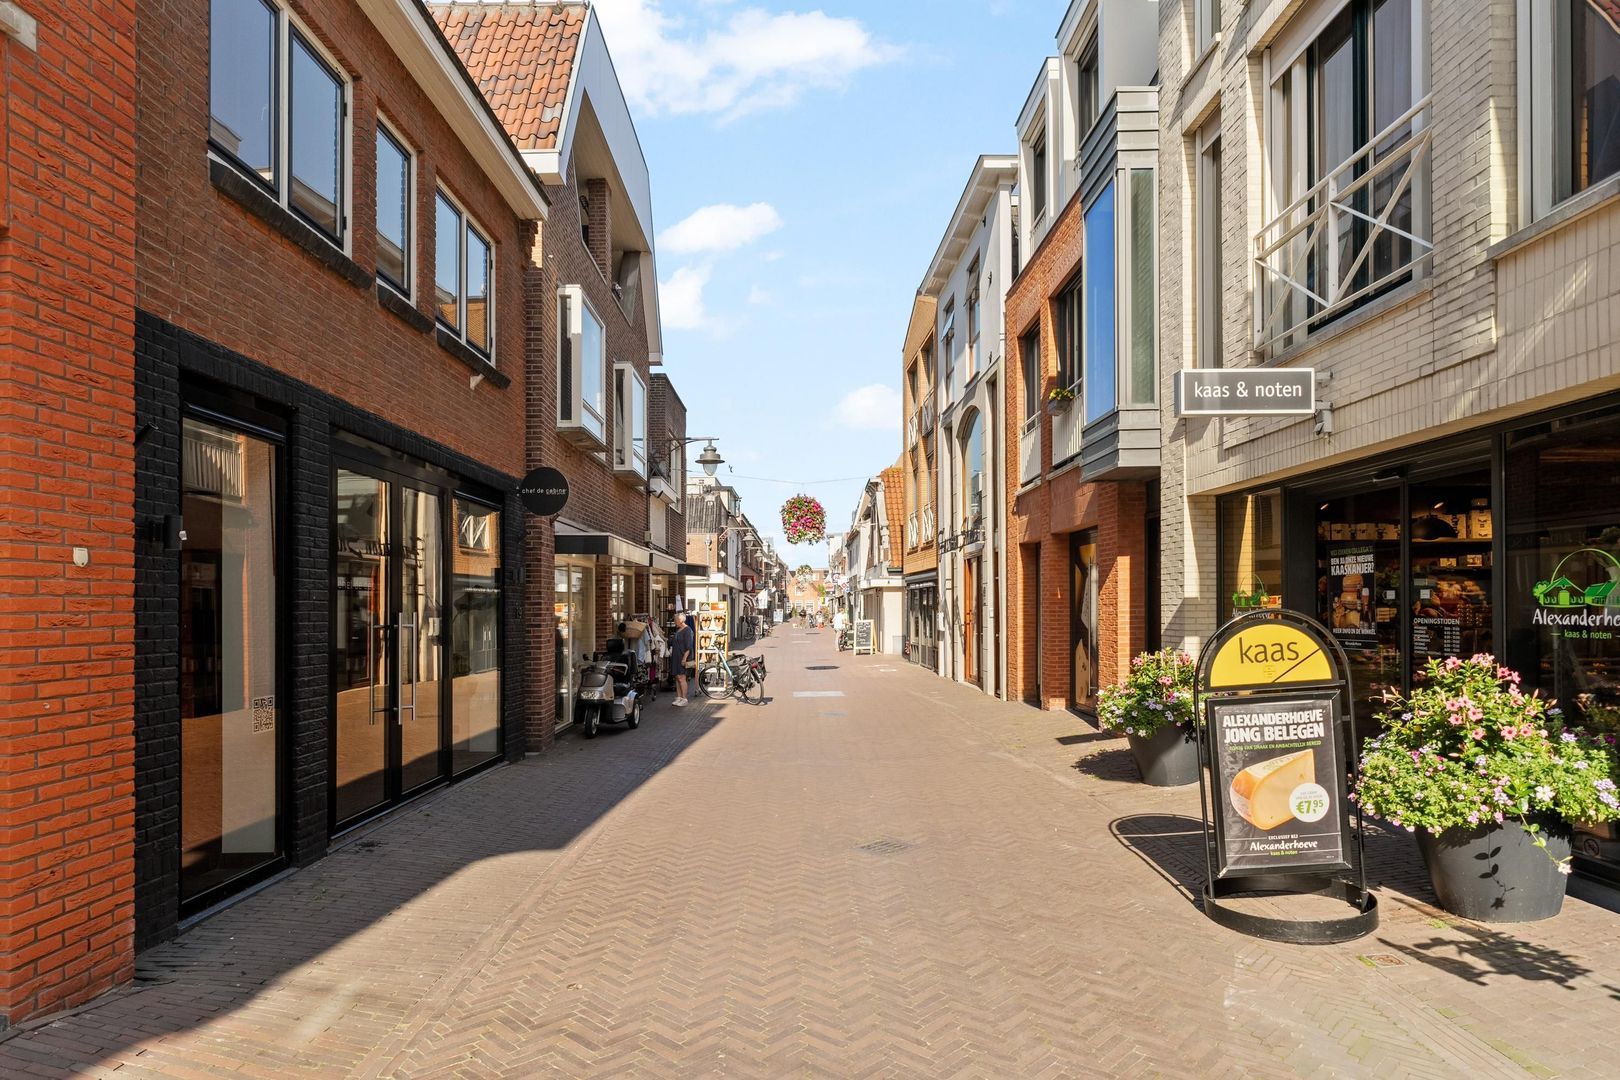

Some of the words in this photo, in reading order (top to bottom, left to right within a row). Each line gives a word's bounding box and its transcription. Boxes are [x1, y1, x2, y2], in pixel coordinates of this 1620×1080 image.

[1194, 381, 1230, 398] kaas
[1236, 381, 1249, 397] &
[1255, 382, 1302, 398] noten
[1564, 630, 1580, 638] kaas
[1582, 630, 1588, 638] &
[1590, 630, 1612, 639] noten
[1239, 637, 1299, 664] kaas
[1223, 709, 1324, 727] ALEXANDERHOEVE
[1224, 727, 1261, 743] JONG
[1264, 723, 1325, 741] BELEGEN
[1250, 840, 1318, 851] Alexanderhoeve
